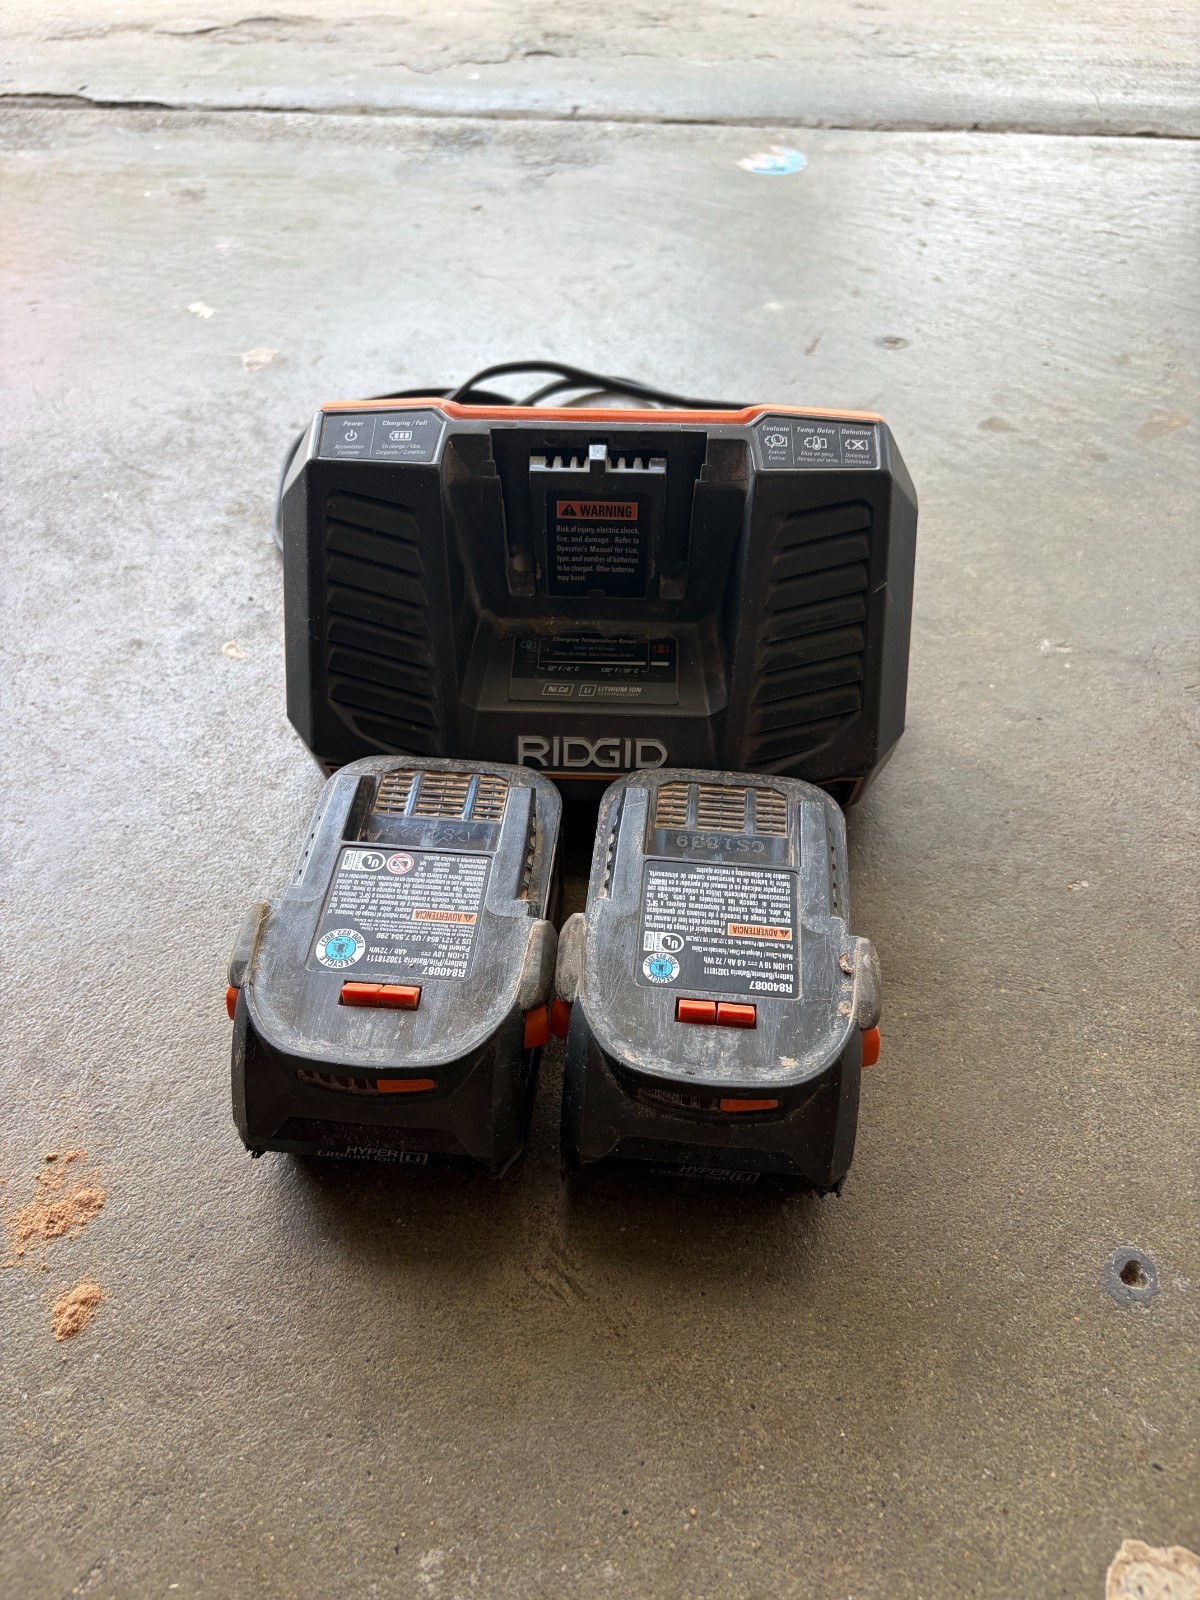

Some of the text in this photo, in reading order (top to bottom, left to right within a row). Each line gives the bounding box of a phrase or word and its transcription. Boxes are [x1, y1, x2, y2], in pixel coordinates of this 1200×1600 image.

[580, 505, 632, 517] WARNING
[620, 527, 639, 535] shock,
[556, 545, 587, 553] Operator's
[518, 735, 668, 768] RIDGID
[364, 856, 381, 867] UL
[657, 892, 669, 900] Siga
[689, 902, 719, 911] temperaturas
[415, 911, 463, 921] ADVERTENCIA
[720, 913, 741, 921] incendio
[750, 914, 767, 923] Riesgo
[673, 923, 689, 932] riesgo
[695, 926, 713, 934] reducir
[733, 926, 777, 936] ADVERTENCIA
[665, 937, 679, 949] UL
[319, 954, 356, 969] RECYCLE
[366, 954, 403, 964] 130218111
[704, 967, 729, 975] 130218111
[773, 962, 793, 971] LI-ION
[421, 967, 465, 977] R840087
[647, 972, 675, 984] RECYCLE
[749, 981, 793, 993] R840087
[346, 1146, 421, 1163] HYPER Li
[680, 1165, 733, 1176] HYPER
